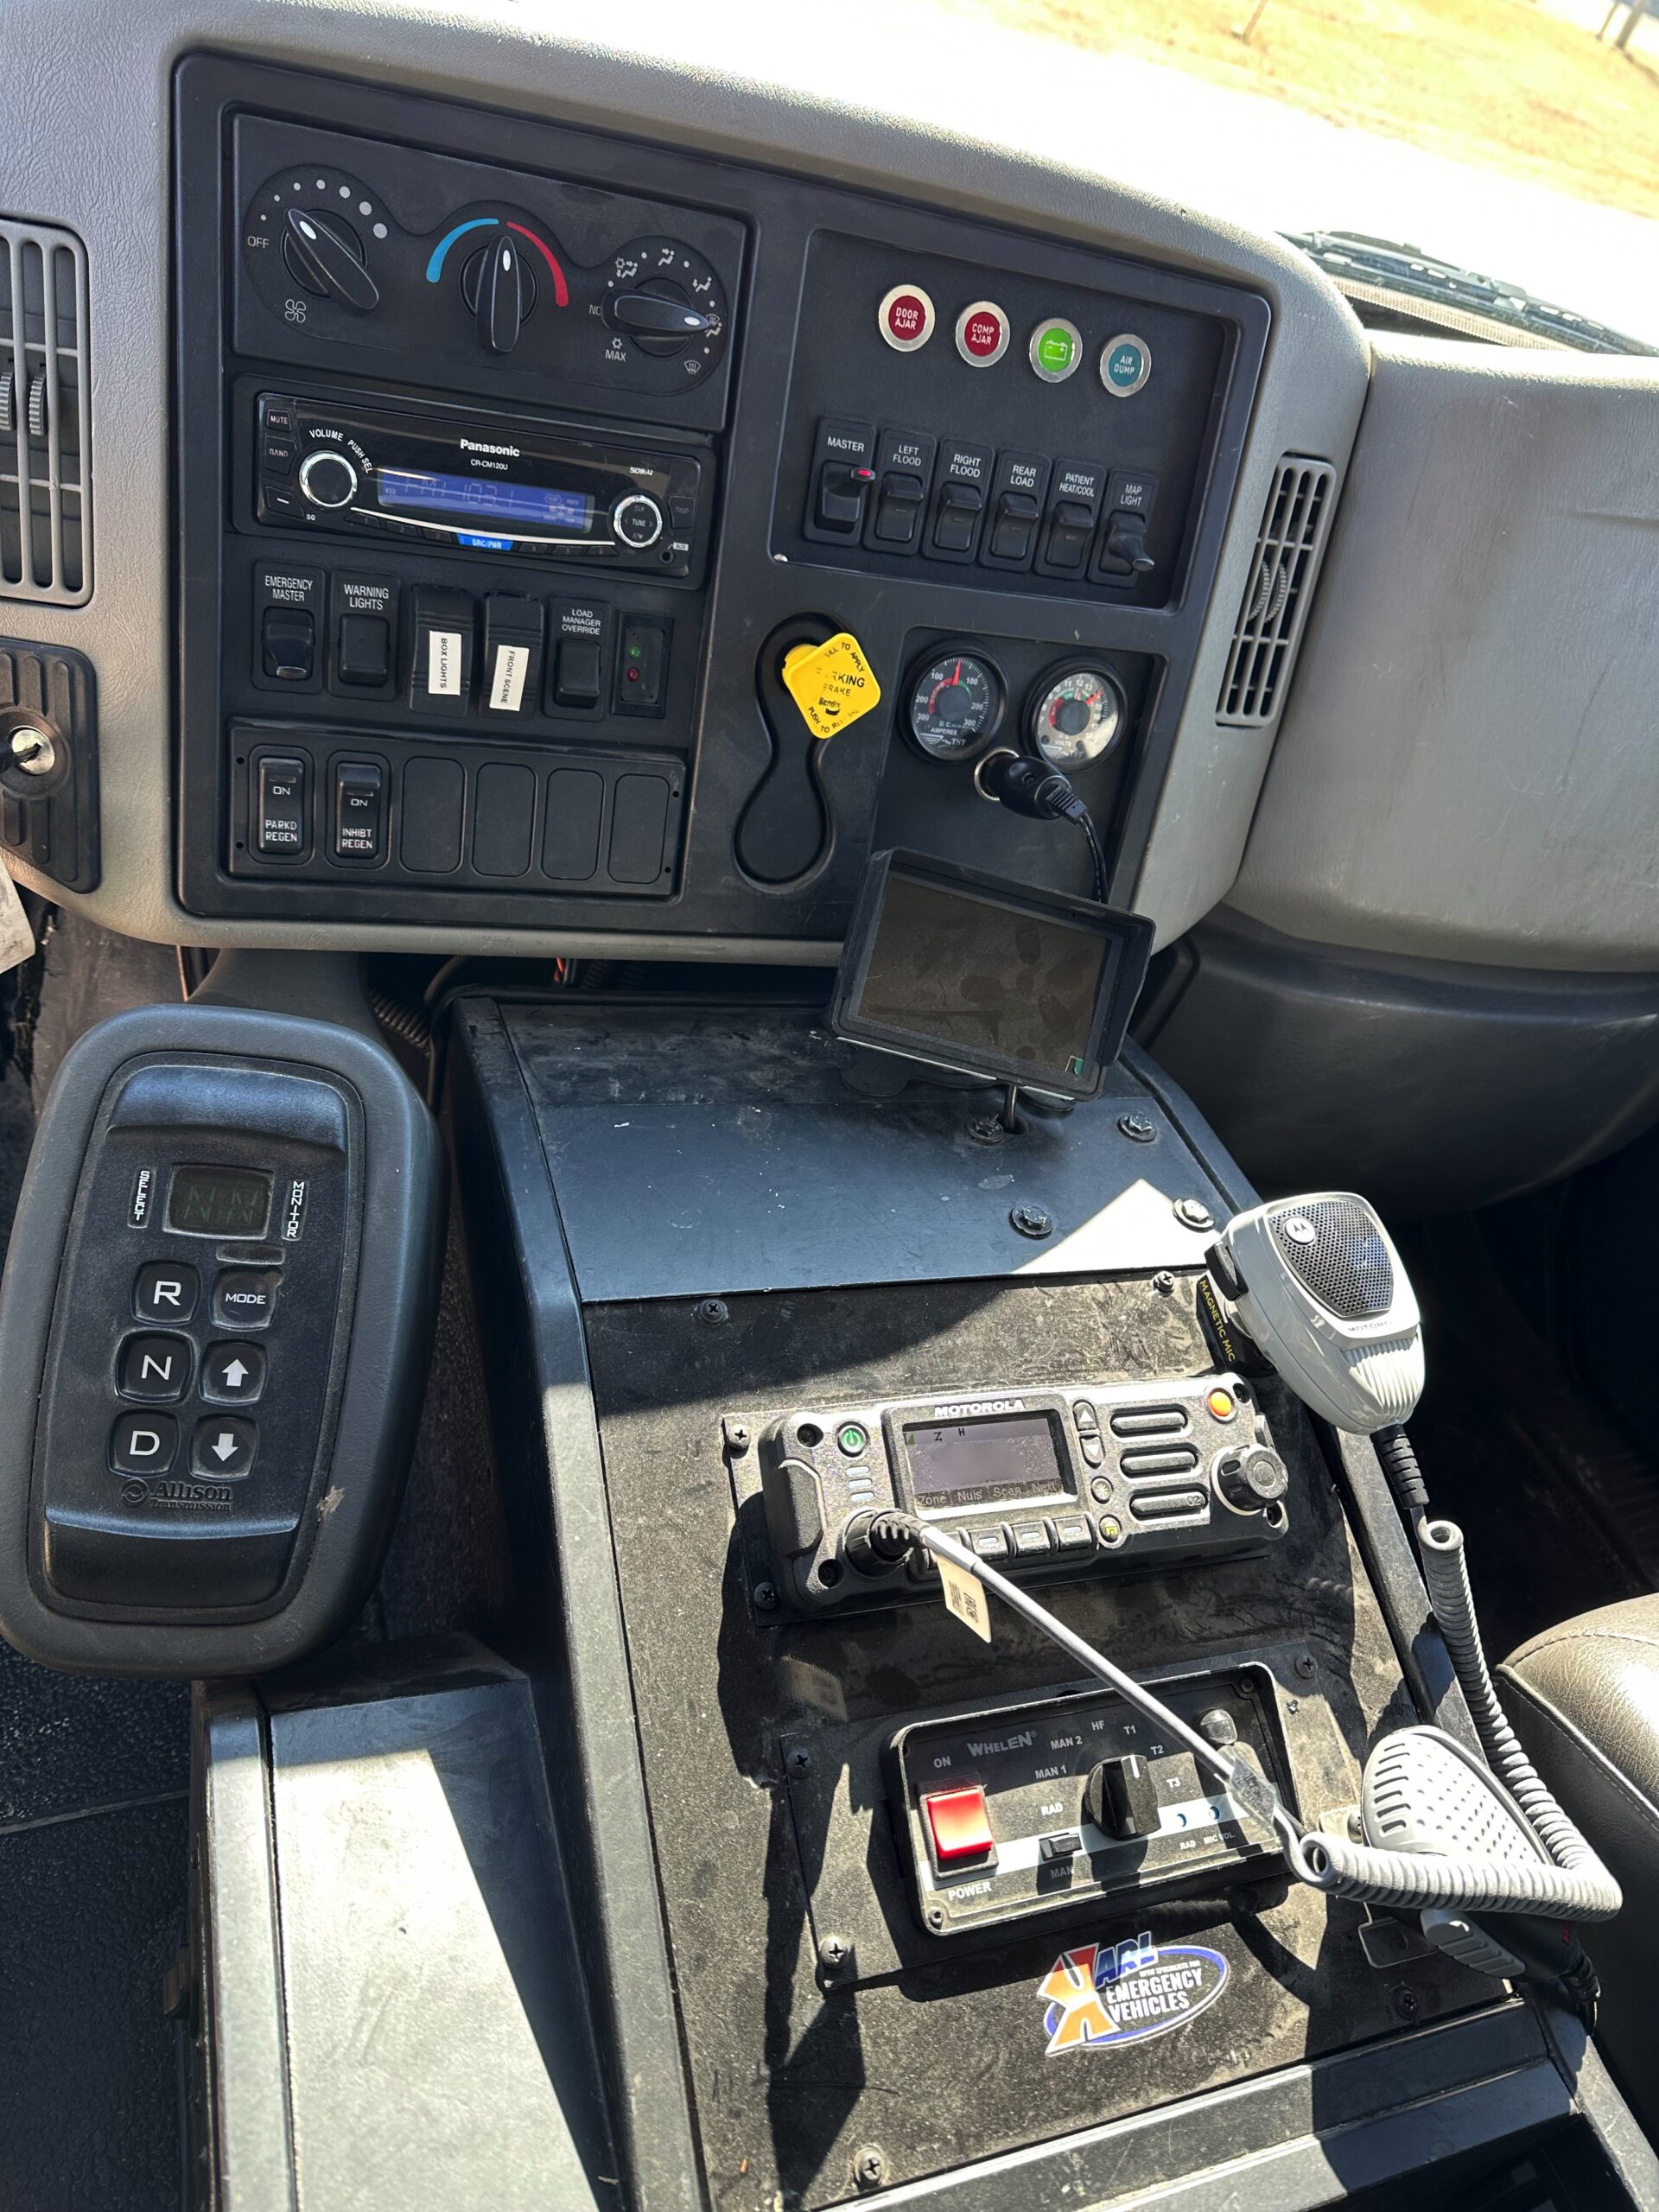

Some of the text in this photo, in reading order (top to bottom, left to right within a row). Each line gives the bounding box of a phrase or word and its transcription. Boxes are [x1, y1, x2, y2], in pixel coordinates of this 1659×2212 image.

[247, 235, 270, 249] OFF
[895, 307, 919, 321] DOOR
[894, 318, 917, 331] AJAR
[971, 323, 995, 336] COMP
[971, 333, 992, 346] AJAR
[605, 349, 626, 362] MAX
[1120, 355, 1134, 365] AIR
[1114, 363, 1135, 375] DUMP
[270, 416, 289, 425] MUTE
[460, 438, 520, 457] Panasonic
[827, 435, 865, 453] MASTER
[898, 445, 919, 456] LEFT
[269, 448, 289, 457] BAND
[308, 429, 373, 474] VOLUME PUSH SEL
[470, 459, 508, 471] CR-CM120U
[893, 454, 921, 467] FLOOD
[953, 454, 981, 467] RIGHT
[950, 465, 981, 478] FLOOD
[1012, 465, 1037, 478] REAR
[1010, 474, 1035, 487] LOAD
[1065, 473, 1095, 486] PATIENT
[1059, 483, 1095, 498] HEAT/COOL
[1124, 484, 1142, 495] MAP
[1120, 494, 1142, 507] LIGHT
[632, 518, 646, 527] TUNE
[472, 538, 502, 550] SRC/PWR
[264, 575, 314, 591] EMERGENCY
[272, 588, 305, 602] MASTER
[343, 583, 389, 600] WARNING
[349, 596, 384, 611] LIGHTS
[571, 608, 593, 619] LOAD
[562, 615, 601, 627] MANAGER
[562, 624, 601, 636] OVERRIDE
[841, 642, 851, 651] TO
[850, 652, 865, 673] APPLY
[440, 658, 448, 689] LIGHTS
[500, 650, 516, 704] FRONT SCENE
[931, 671, 944, 681] 100
[966, 677, 979, 685] 100
[916, 695, 929, 703] 200
[808, 706, 830, 734] PUSH TO
[917, 713, 930, 721] 300
[963, 718, 976, 727] 300
[930, 727, 957, 735] AMPERES
[273, 785, 290, 795] ON
[350, 798, 368, 807] ON
[265, 820, 297, 830] PARKD
[265, 831, 297, 842] REGEN
[342, 828, 372, 838] INHIBT
[341, 839, 372, 849] REGEN
[134, 1170, 150, 1221] SELECT
[287, 1180, 305, 1238] MONITOR
[153, 1281, 181, 1306] R
[225, 1293, 266, 1305] MODE
[1199, 1279, 1236, 1363] MAGNETIC MIC
[141, 1355, 172, 1381] N
[934, 1398, 1026, 1418] MOTOROLA
[130, 1430, 161, 1456] D
[156, 1480, 232, 1500] Allison
[918, 1491, 947, 1507] Zone
[957, 1489, 982, 1503] Nuis
[993, 1485, 1021, 1500] Scan
[150, 1497, 231, 1511] Transmission
[1090, 1719, 1105, 1732] HF
[1123, 1725, 1137, 1736] T1
[1050, 1735, 1083, 1751] MAN 2
[1150, 1745, 1165, 1756] T2
[933, 1756, 951, 1769] ON
[1035, 1764, 1067, 1780] MAN 1
[1166, 1777, 1181, 1789] T3
[1040, 1802, 1064, 1816] RAD
[1179, 1840, 1197, 1850] RAD
[1203, 1834, 1218, 1845] MIC
[1050, 1866, 1075, 1879] MAN
[948, 1881, 993, 1901] POWER
[1106, 1967, 1203, 2005] EMERGENCY
[1108, 1991, 1191, 2023] VEHICLES
